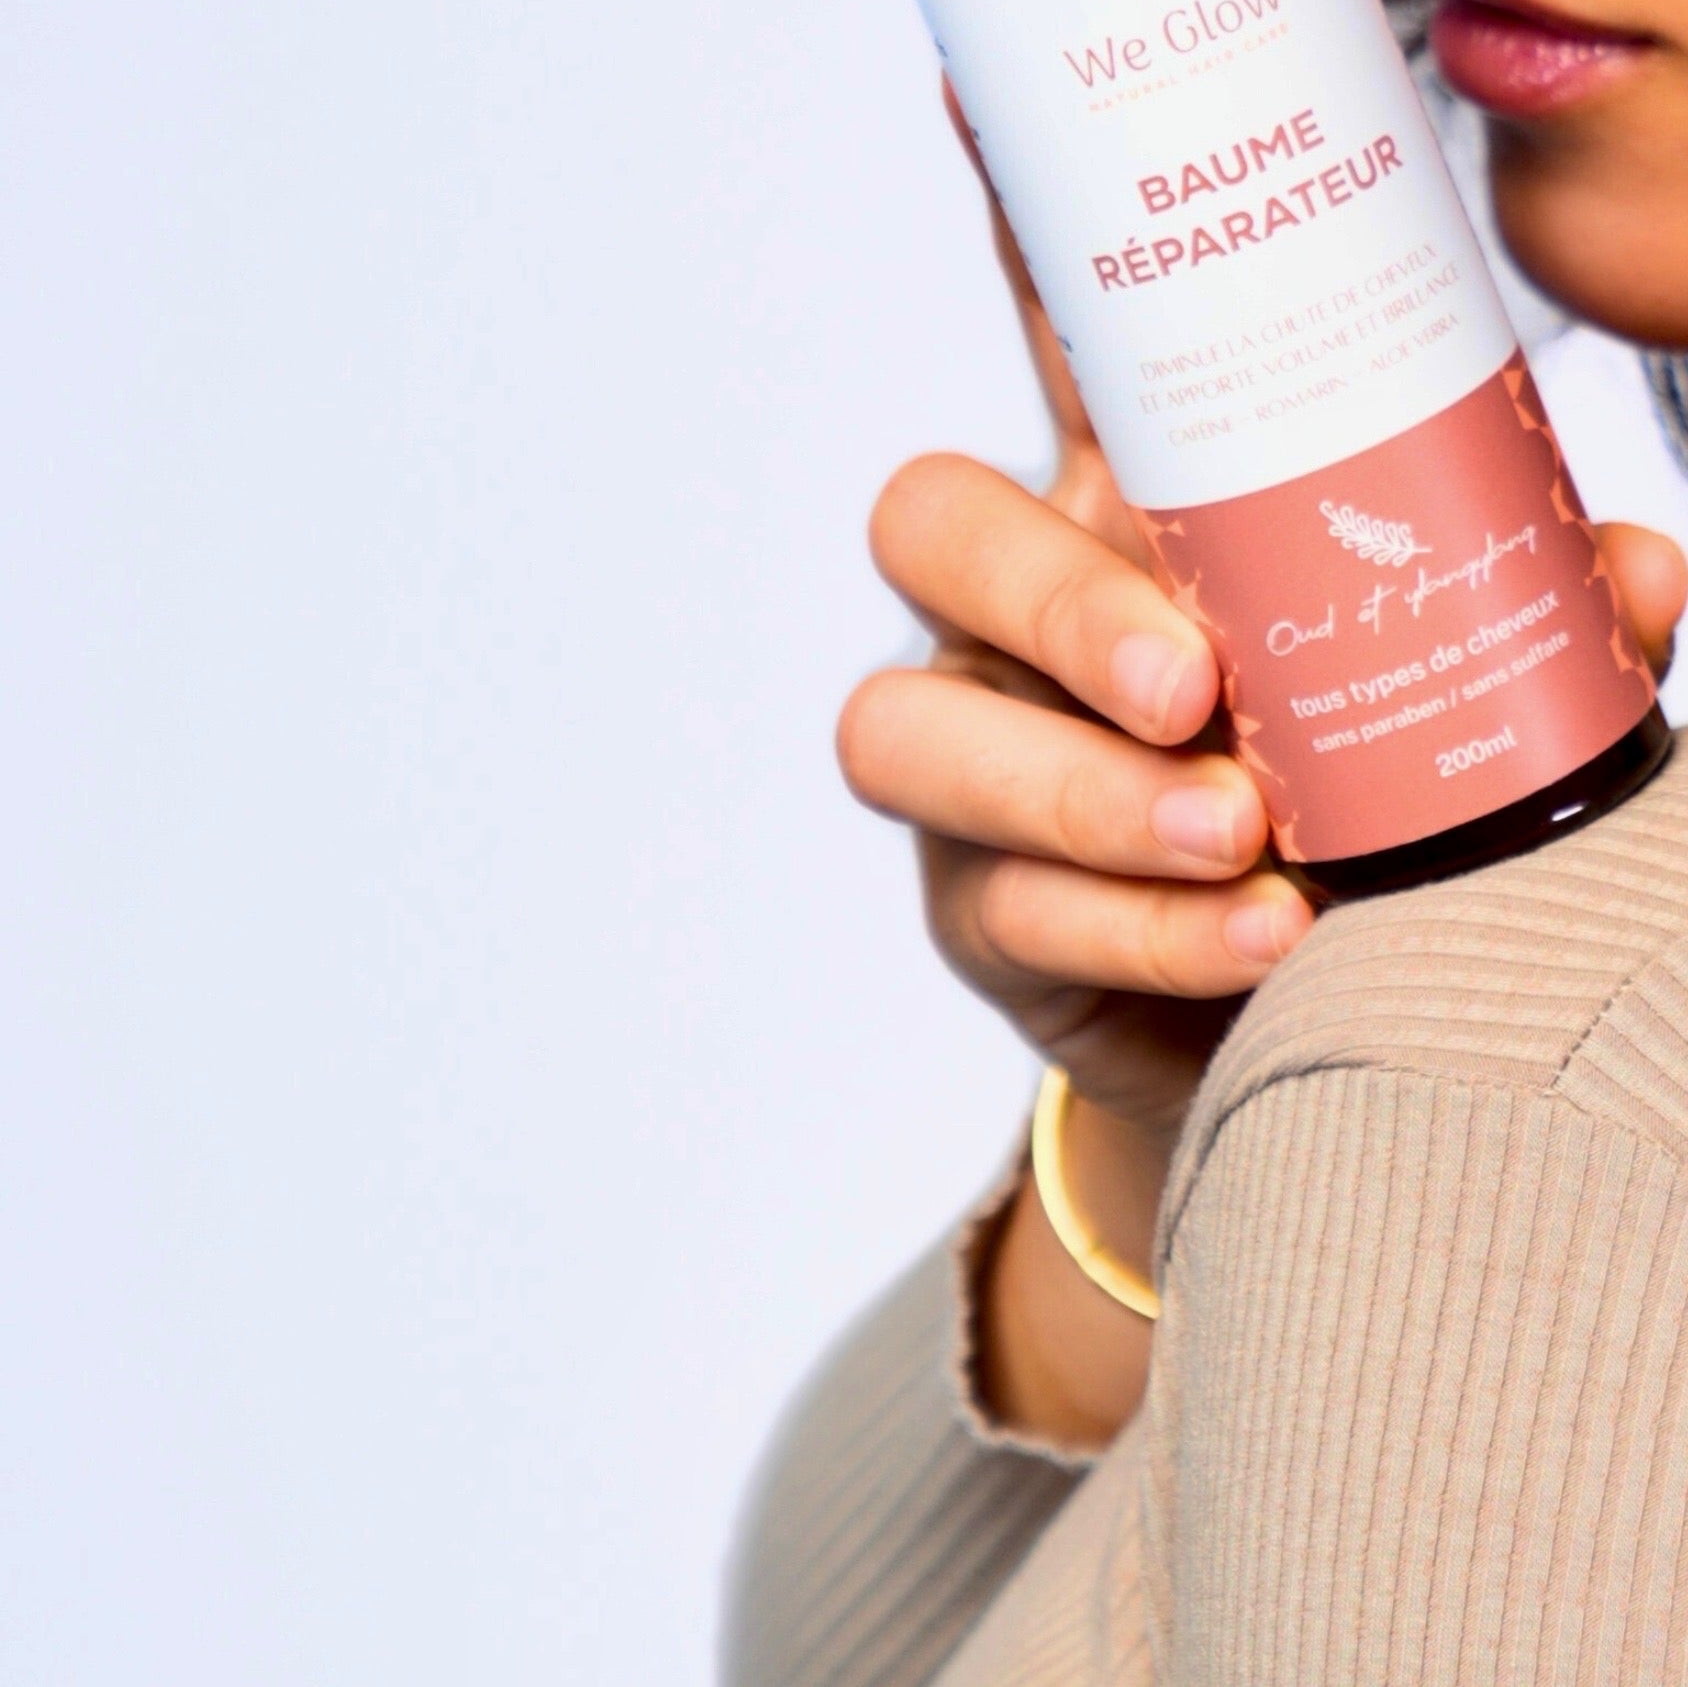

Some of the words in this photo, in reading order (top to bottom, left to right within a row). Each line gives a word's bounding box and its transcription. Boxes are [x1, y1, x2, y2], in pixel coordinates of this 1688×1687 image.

[1063, 36, 1152, 88] We
[1092, 134, 1404, 292] RÉPARATEUR
[1137, 109, 1325, 215] BAUME
[1138, 390, 1160, 415] ET
[1166, 368, 1257, 408] APPORTE
[1354, 313, 1378, 339] ET
[1382, 260, 1462, 326] BRILLANCE
[1226, 333, 1258, 358] LA
[1331, 285, 1360, 314] DE
[1364, 242, 1439, 297] CHEVEUX
[1254, 374, 1349, 423] ROMARIN
[1369, 339, 1413, 372] ALOE
[1266, 603, 1334, 657] Oud
[1357, 584, 1397, 635] et
[1290, 688, 1347, 720] tous
[1348, 660, 1427, 705] types
[1429, 643, 1464, 673] de
[1466, 590, 1560, 656] cheveux
[1312, 726, 1359, 753] sans
[1360, 696, 1447, 744] paraben
[1460, 665, 1510, 701] sans
[1509, 630, 1571, 678] sulfate
[1434, 724, 1518, 778] 200ml
